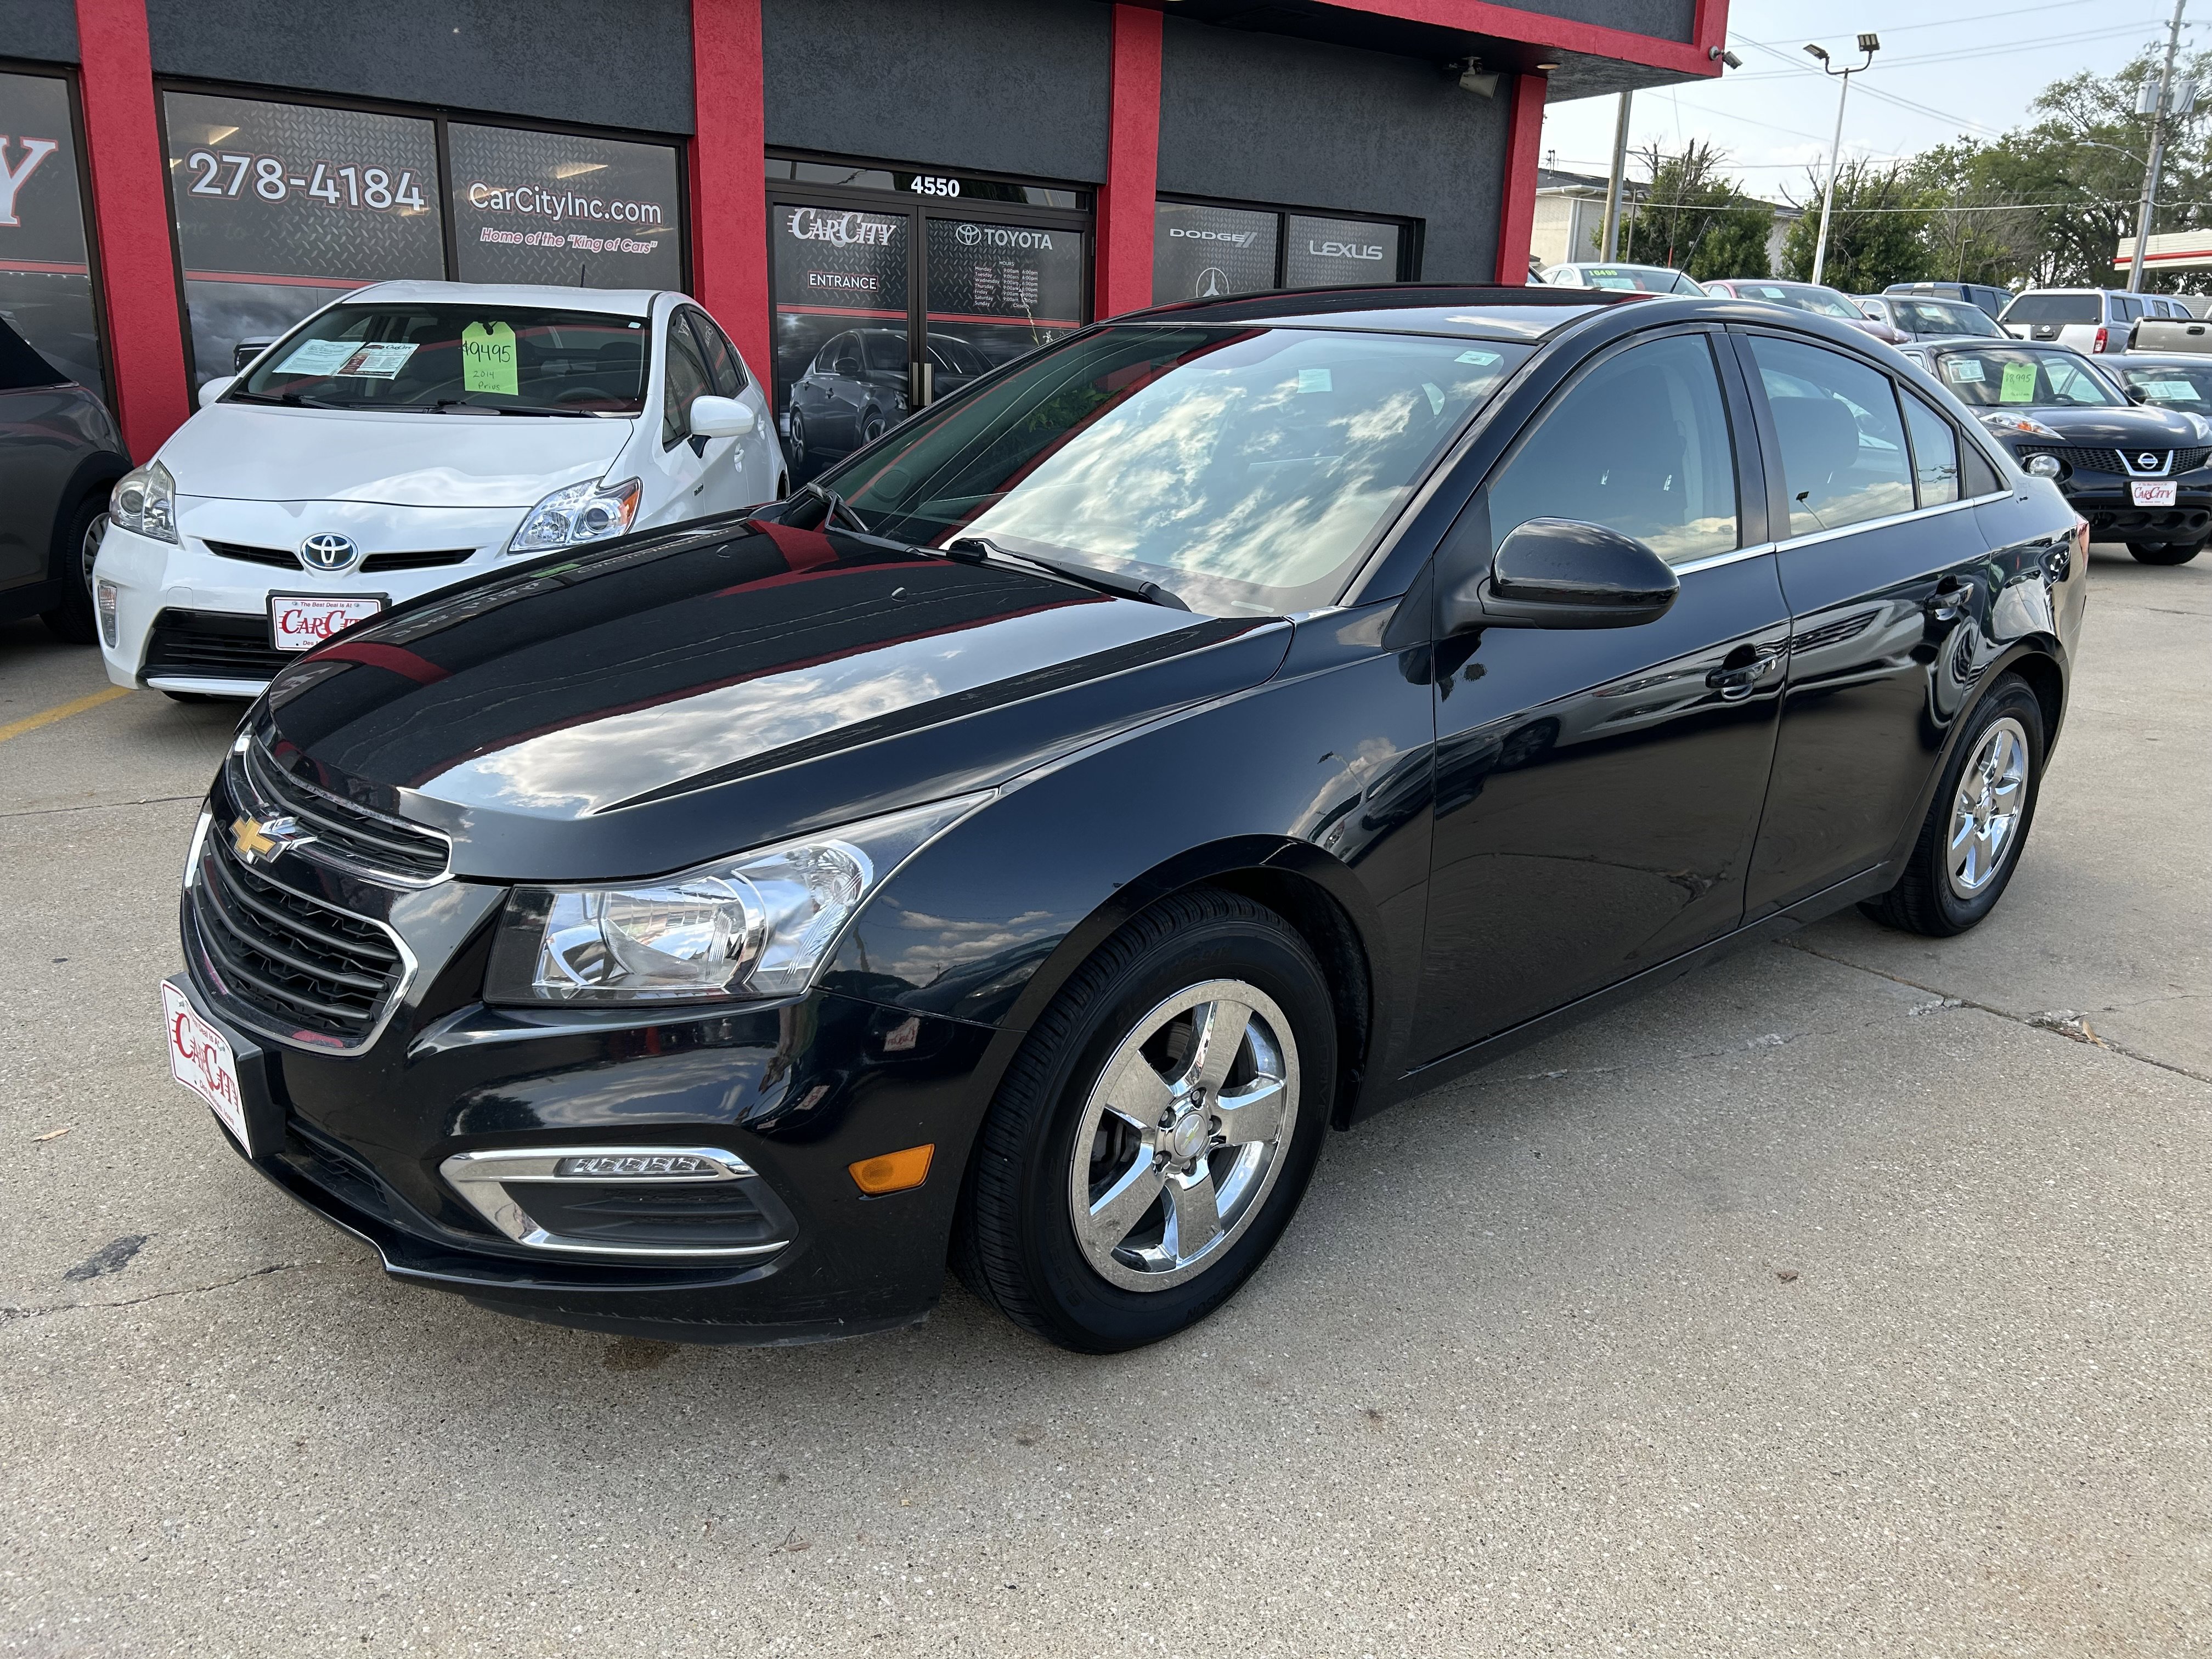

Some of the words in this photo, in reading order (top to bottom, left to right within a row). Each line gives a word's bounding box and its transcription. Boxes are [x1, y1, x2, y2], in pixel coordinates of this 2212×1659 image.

[189, 151, 425, 212] 278-4184
[911, 176, 960, 197] 4550
[469, 182, 662, 224] CarCityInc.com
[480, 227, 523, 244] Home
[525, 232, 541, 246] of
[541, 233, 566, 247] the
[605, 238, 620, 252] of
[984, 228, 1053, 250] TOYOTA
[1169, 228, 1246, 242] DODGE
[1309, 240, 1383, 261] LEXUS
[809, 273, 877, 290] ENTRANCE
[462, 340, 511, 363] $9495
[473, 370, 494, 379] 2014
[478, 381, 500, 391] Prius
